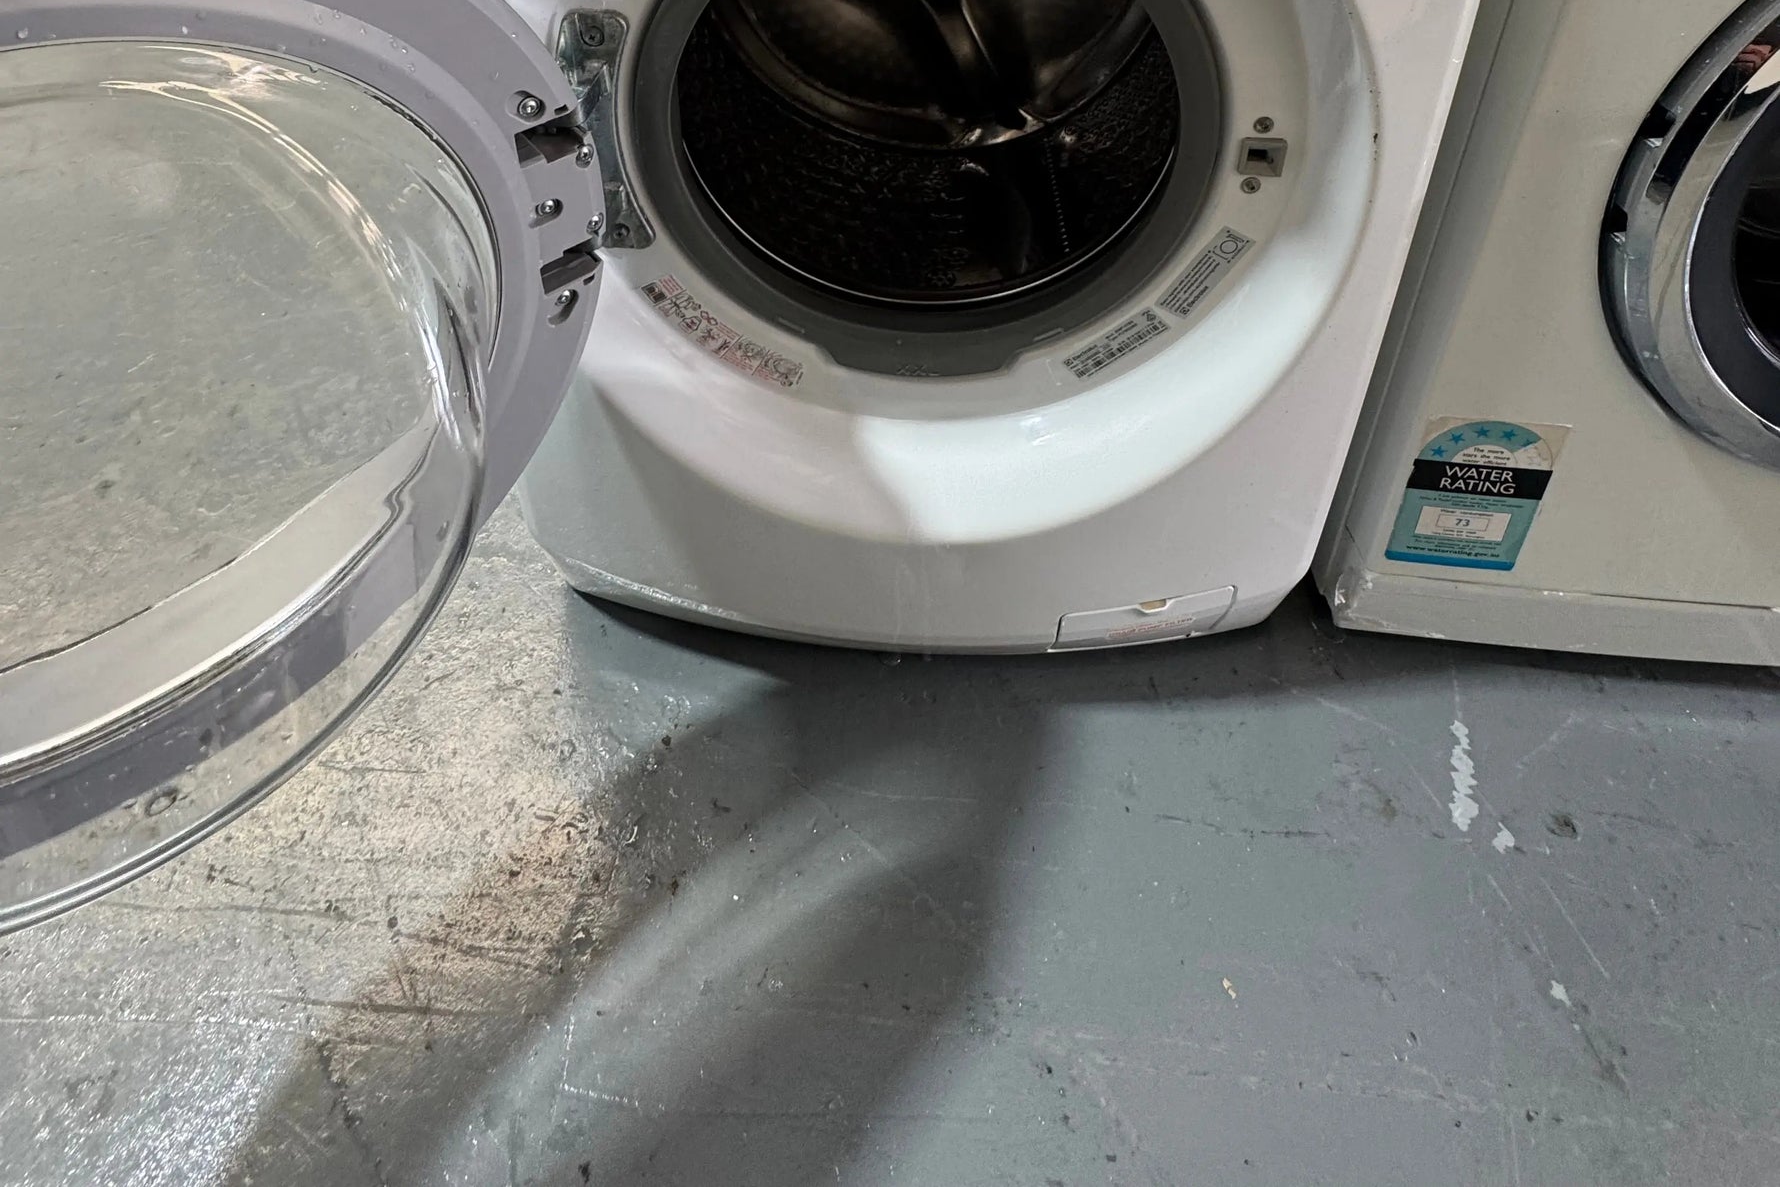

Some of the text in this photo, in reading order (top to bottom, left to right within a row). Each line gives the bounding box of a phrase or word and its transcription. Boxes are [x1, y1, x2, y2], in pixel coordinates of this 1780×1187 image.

[1445, 465, 1513, 482] WATER
[1439, 477, 1516, 495] RATING
[1455, 518, 1471, 527] 73
